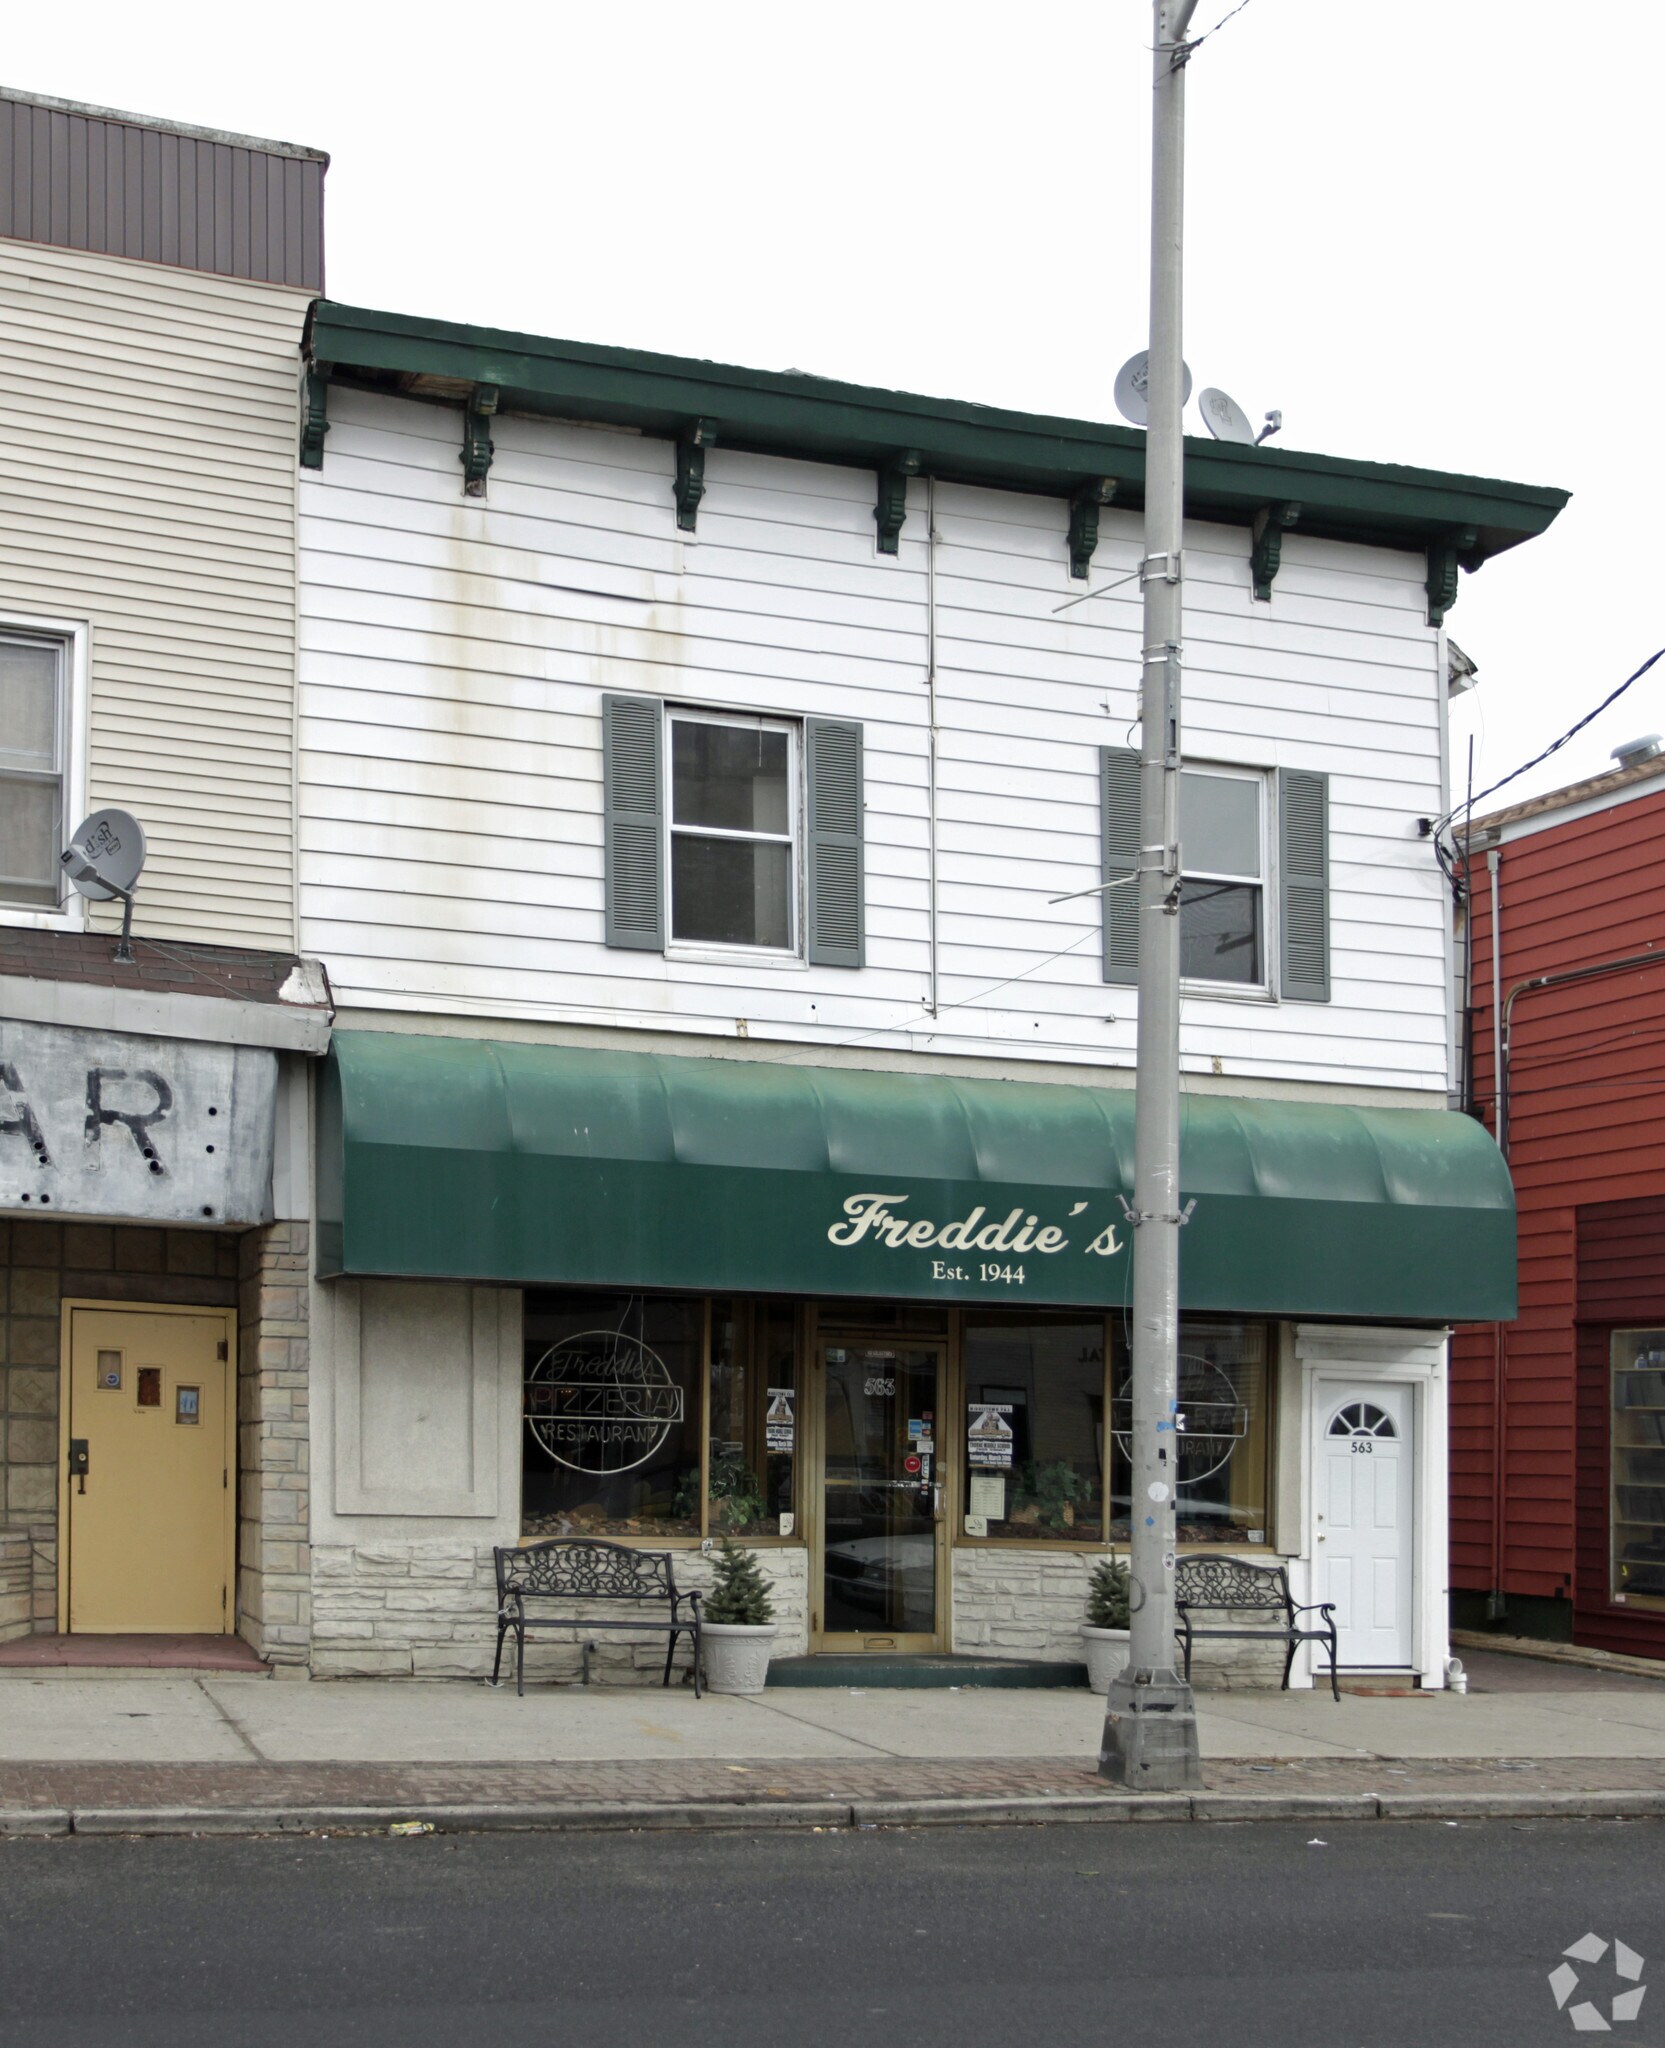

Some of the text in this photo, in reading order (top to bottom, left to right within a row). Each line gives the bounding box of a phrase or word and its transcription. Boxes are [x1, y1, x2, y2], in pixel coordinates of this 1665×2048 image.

[931, 1260, 1026, 1285] Est. 1944
[863, 1377, 896, 1397] 563
[533, 1386, 674, 1415] PIZZERIA
[543, 1422, 659, 1443] RESTAURANT
[1351, 1442, 1373, 1454] 563
